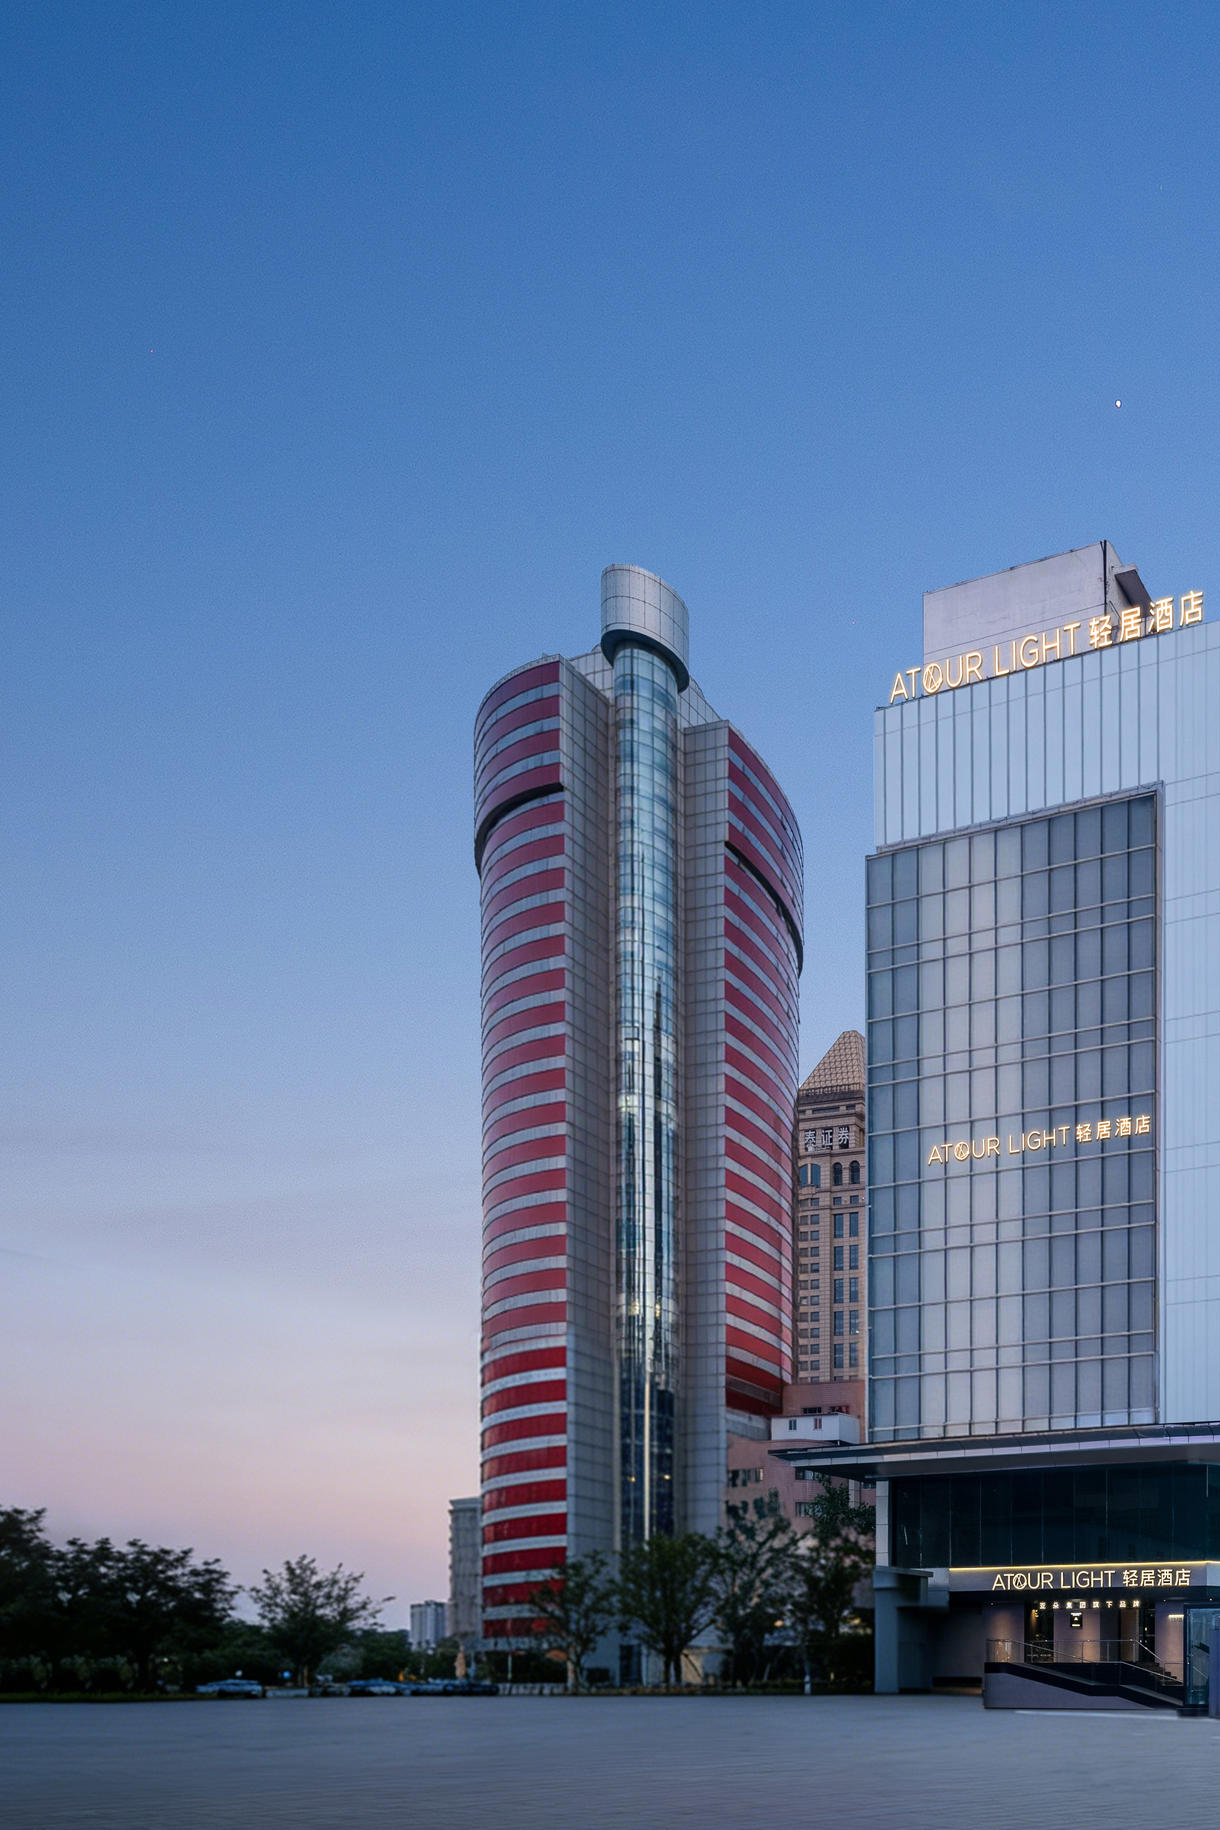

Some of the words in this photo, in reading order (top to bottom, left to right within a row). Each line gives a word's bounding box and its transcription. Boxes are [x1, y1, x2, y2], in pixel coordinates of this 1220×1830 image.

[890, 652, 983, 704] ATOUR
[993, 622, 1081, 677] LIGHT
[1088, 590, 1204, 648] 轻居酒店
[928, 1137, 1000, 1166] ATOUR
[1008, 1126, 1070, 1154] LIGHT
[1075, 1115, 1151, 1143] 轻居酒店
[992, 1572, 1054, 1591] ATOUR
[1060, 1570, 1115, 1589] LIGHT
[1122, 1568, 1191, 1587] 轻居酒店
